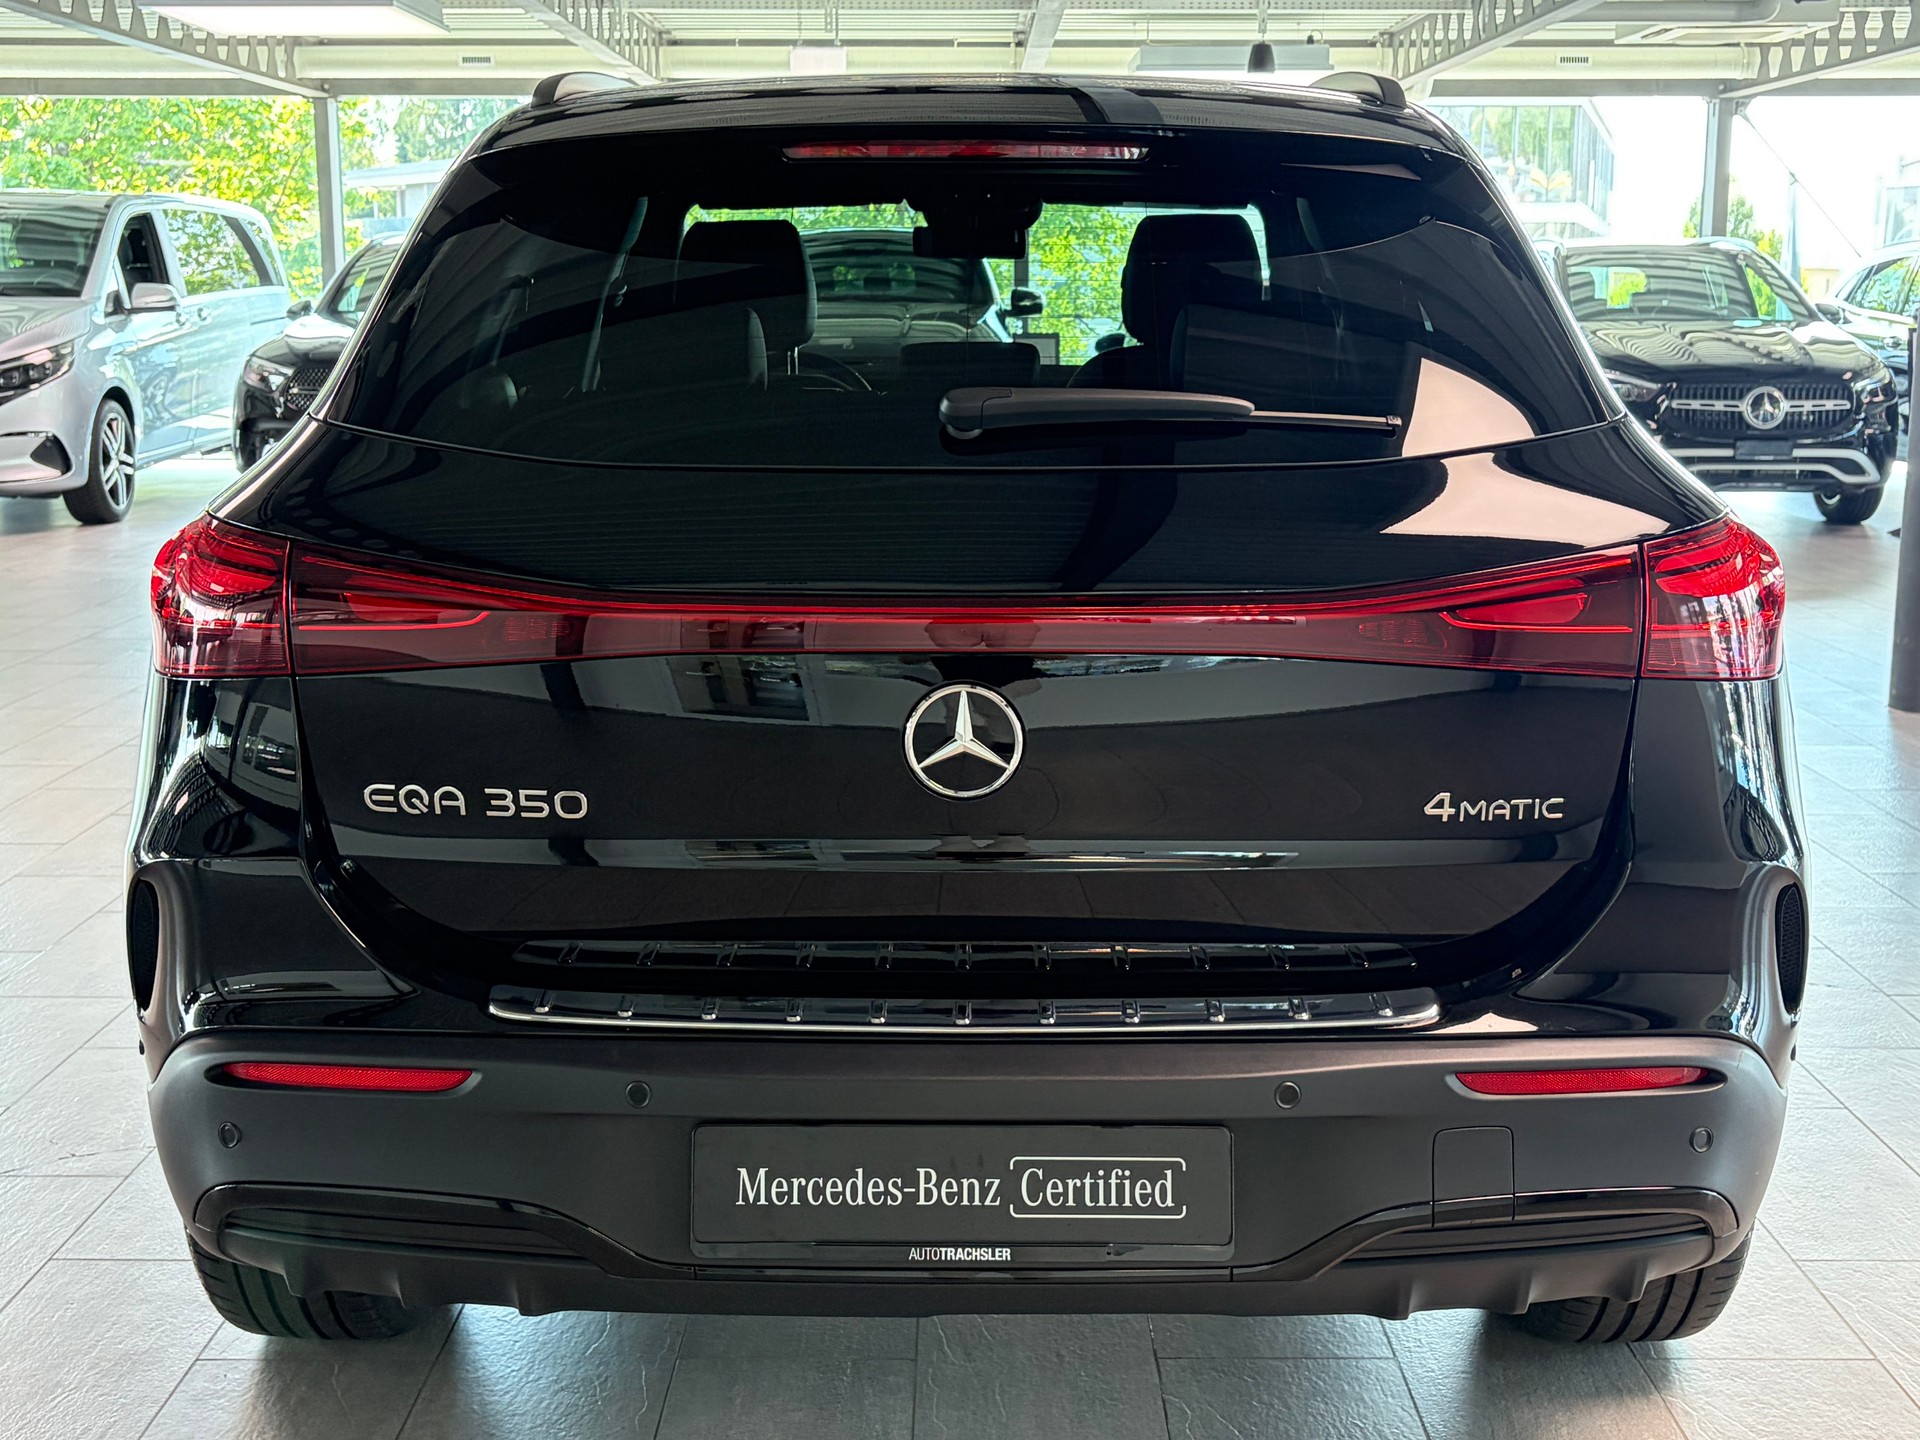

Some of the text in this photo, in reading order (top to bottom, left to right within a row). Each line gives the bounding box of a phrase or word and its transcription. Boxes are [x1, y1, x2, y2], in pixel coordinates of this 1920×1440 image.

[363, 783, 588, 819] EQA 350
[1423, 792, 1565, 822] 4MATIC
[735, 1167, 1175, 1208] Mercedes-Benz Certified
[908, 1246, 1012, 1262] AUTOTRACHSLER
